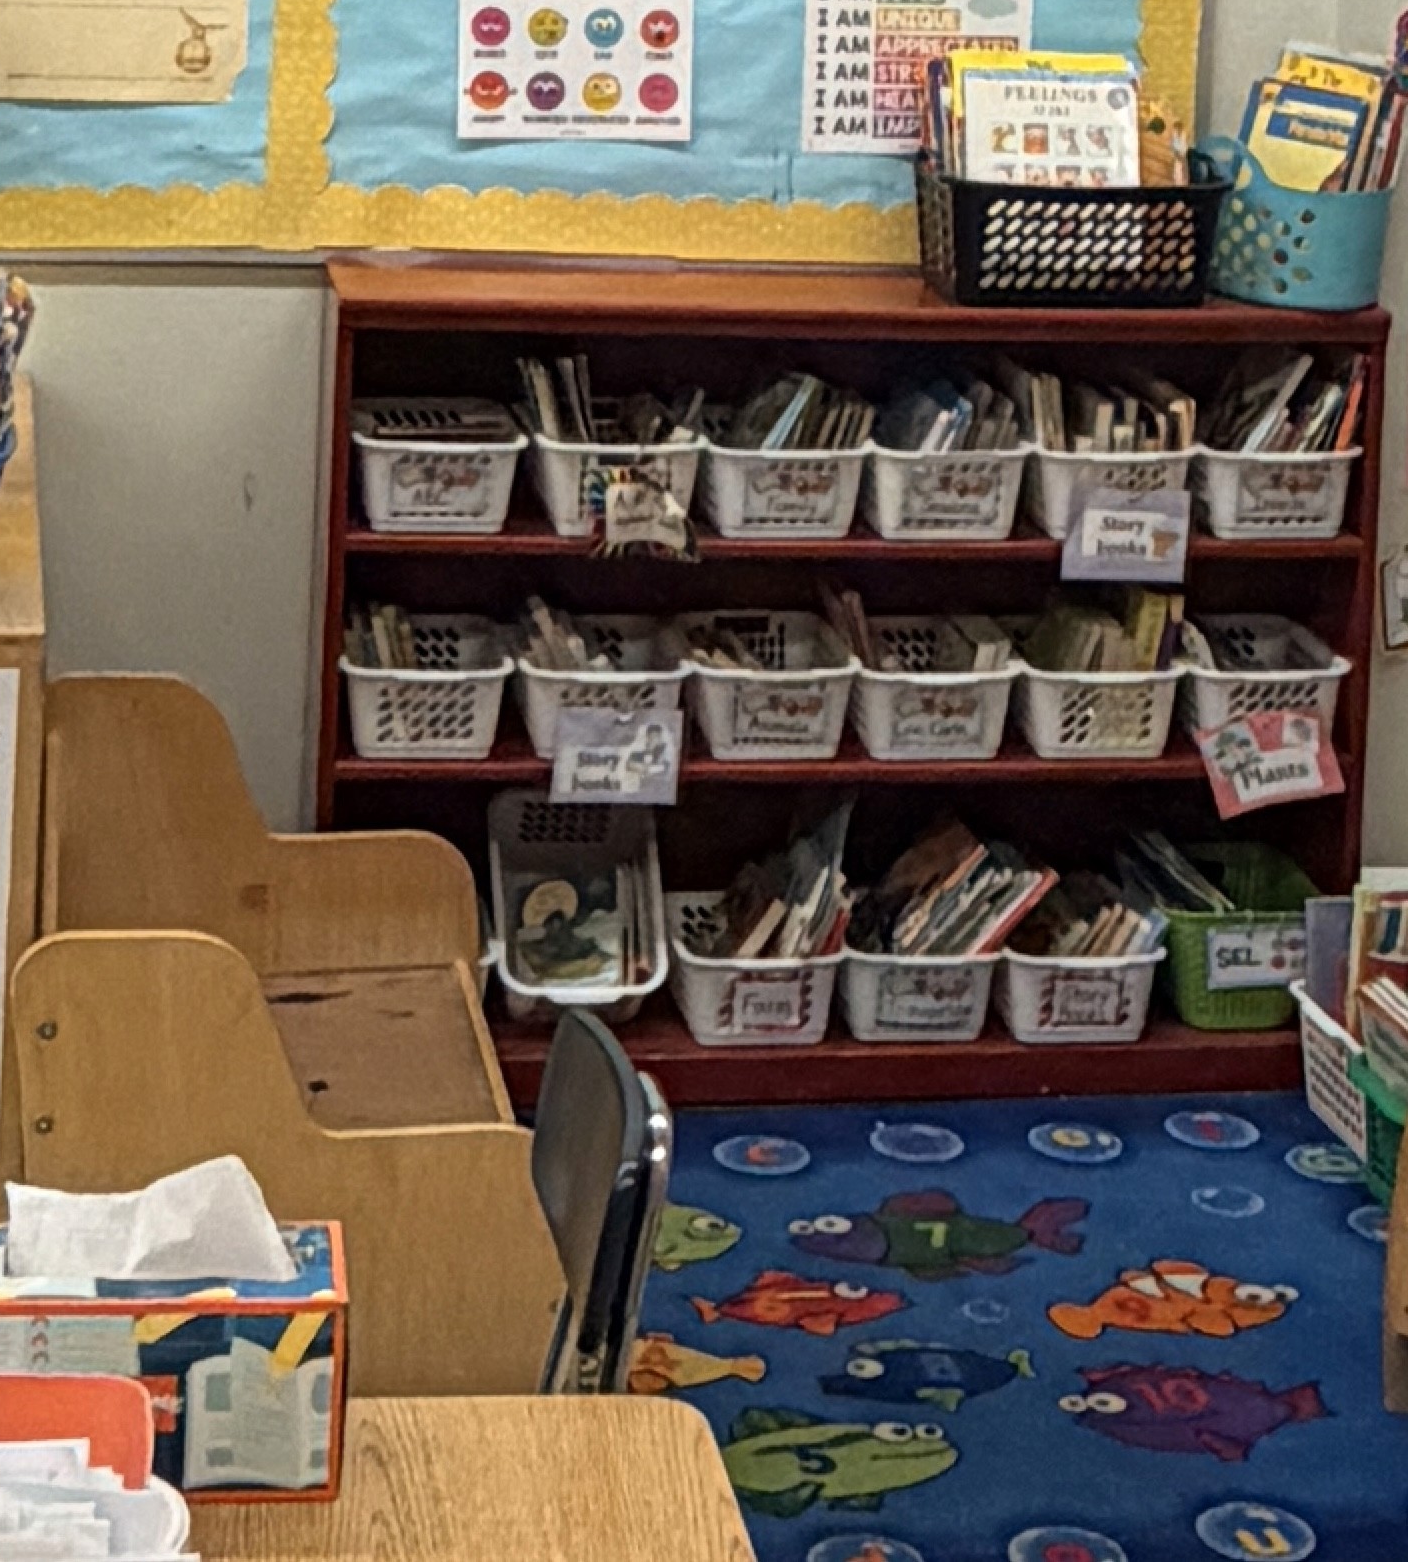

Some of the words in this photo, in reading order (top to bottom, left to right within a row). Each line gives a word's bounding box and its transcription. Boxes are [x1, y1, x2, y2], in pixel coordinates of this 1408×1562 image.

[836, 8, 871, 27] AM
[835, 35, 870, 55] AM
[834, 62, 869, 81] AM
[834, 89, 868, 108] AM
[1003, 85, 1098, 103] FEELINGS
[832, 116, 867, 135] AM
[1101, 515, 1146, 536] Story
[1238, 761, 1310, 794] Plants
[1216, 947, 1262, 969] SEL
